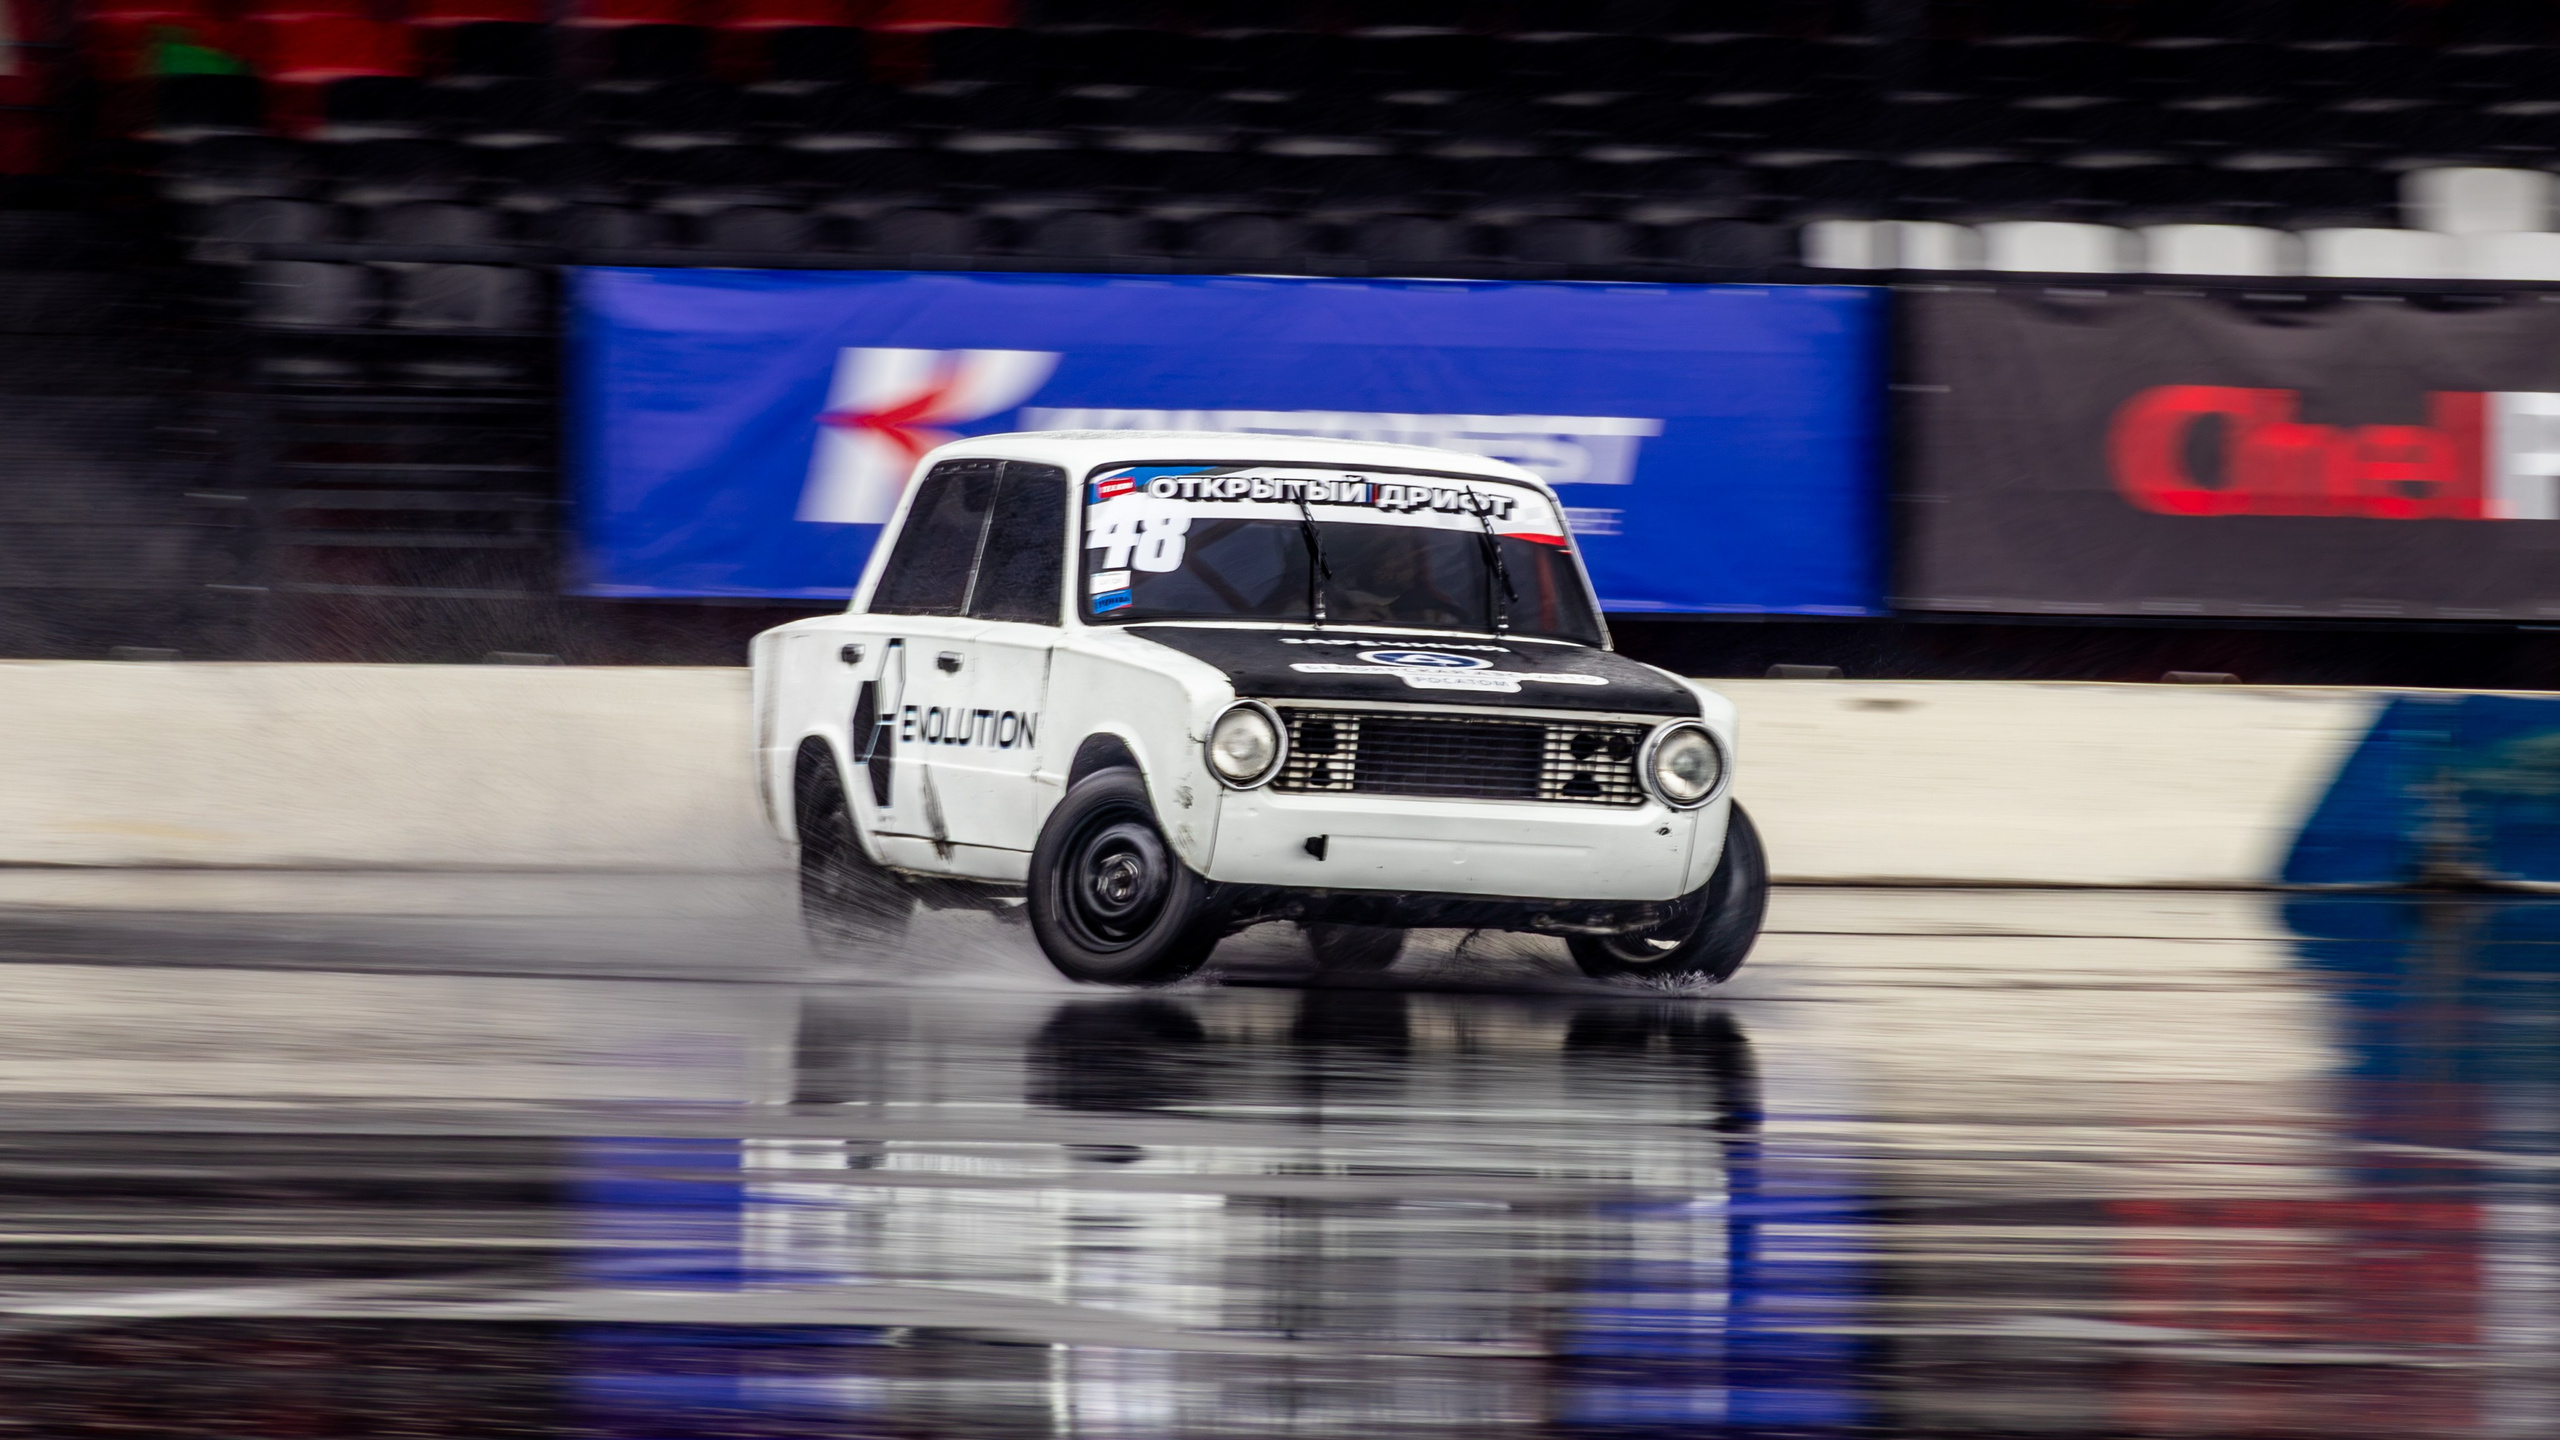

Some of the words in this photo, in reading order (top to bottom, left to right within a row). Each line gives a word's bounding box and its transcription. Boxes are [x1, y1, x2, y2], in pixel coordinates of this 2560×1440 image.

[1150, 475, 1367, 505] ОТКРЫТЫЙ
[1375, 484, 1515, 518] ДРИФТ
[1086, 493, 1192, 573] 48
[1414, 676, 1511, 688] РОСАТОМ
[901, 704, 1038, 750] EVOLUTION
